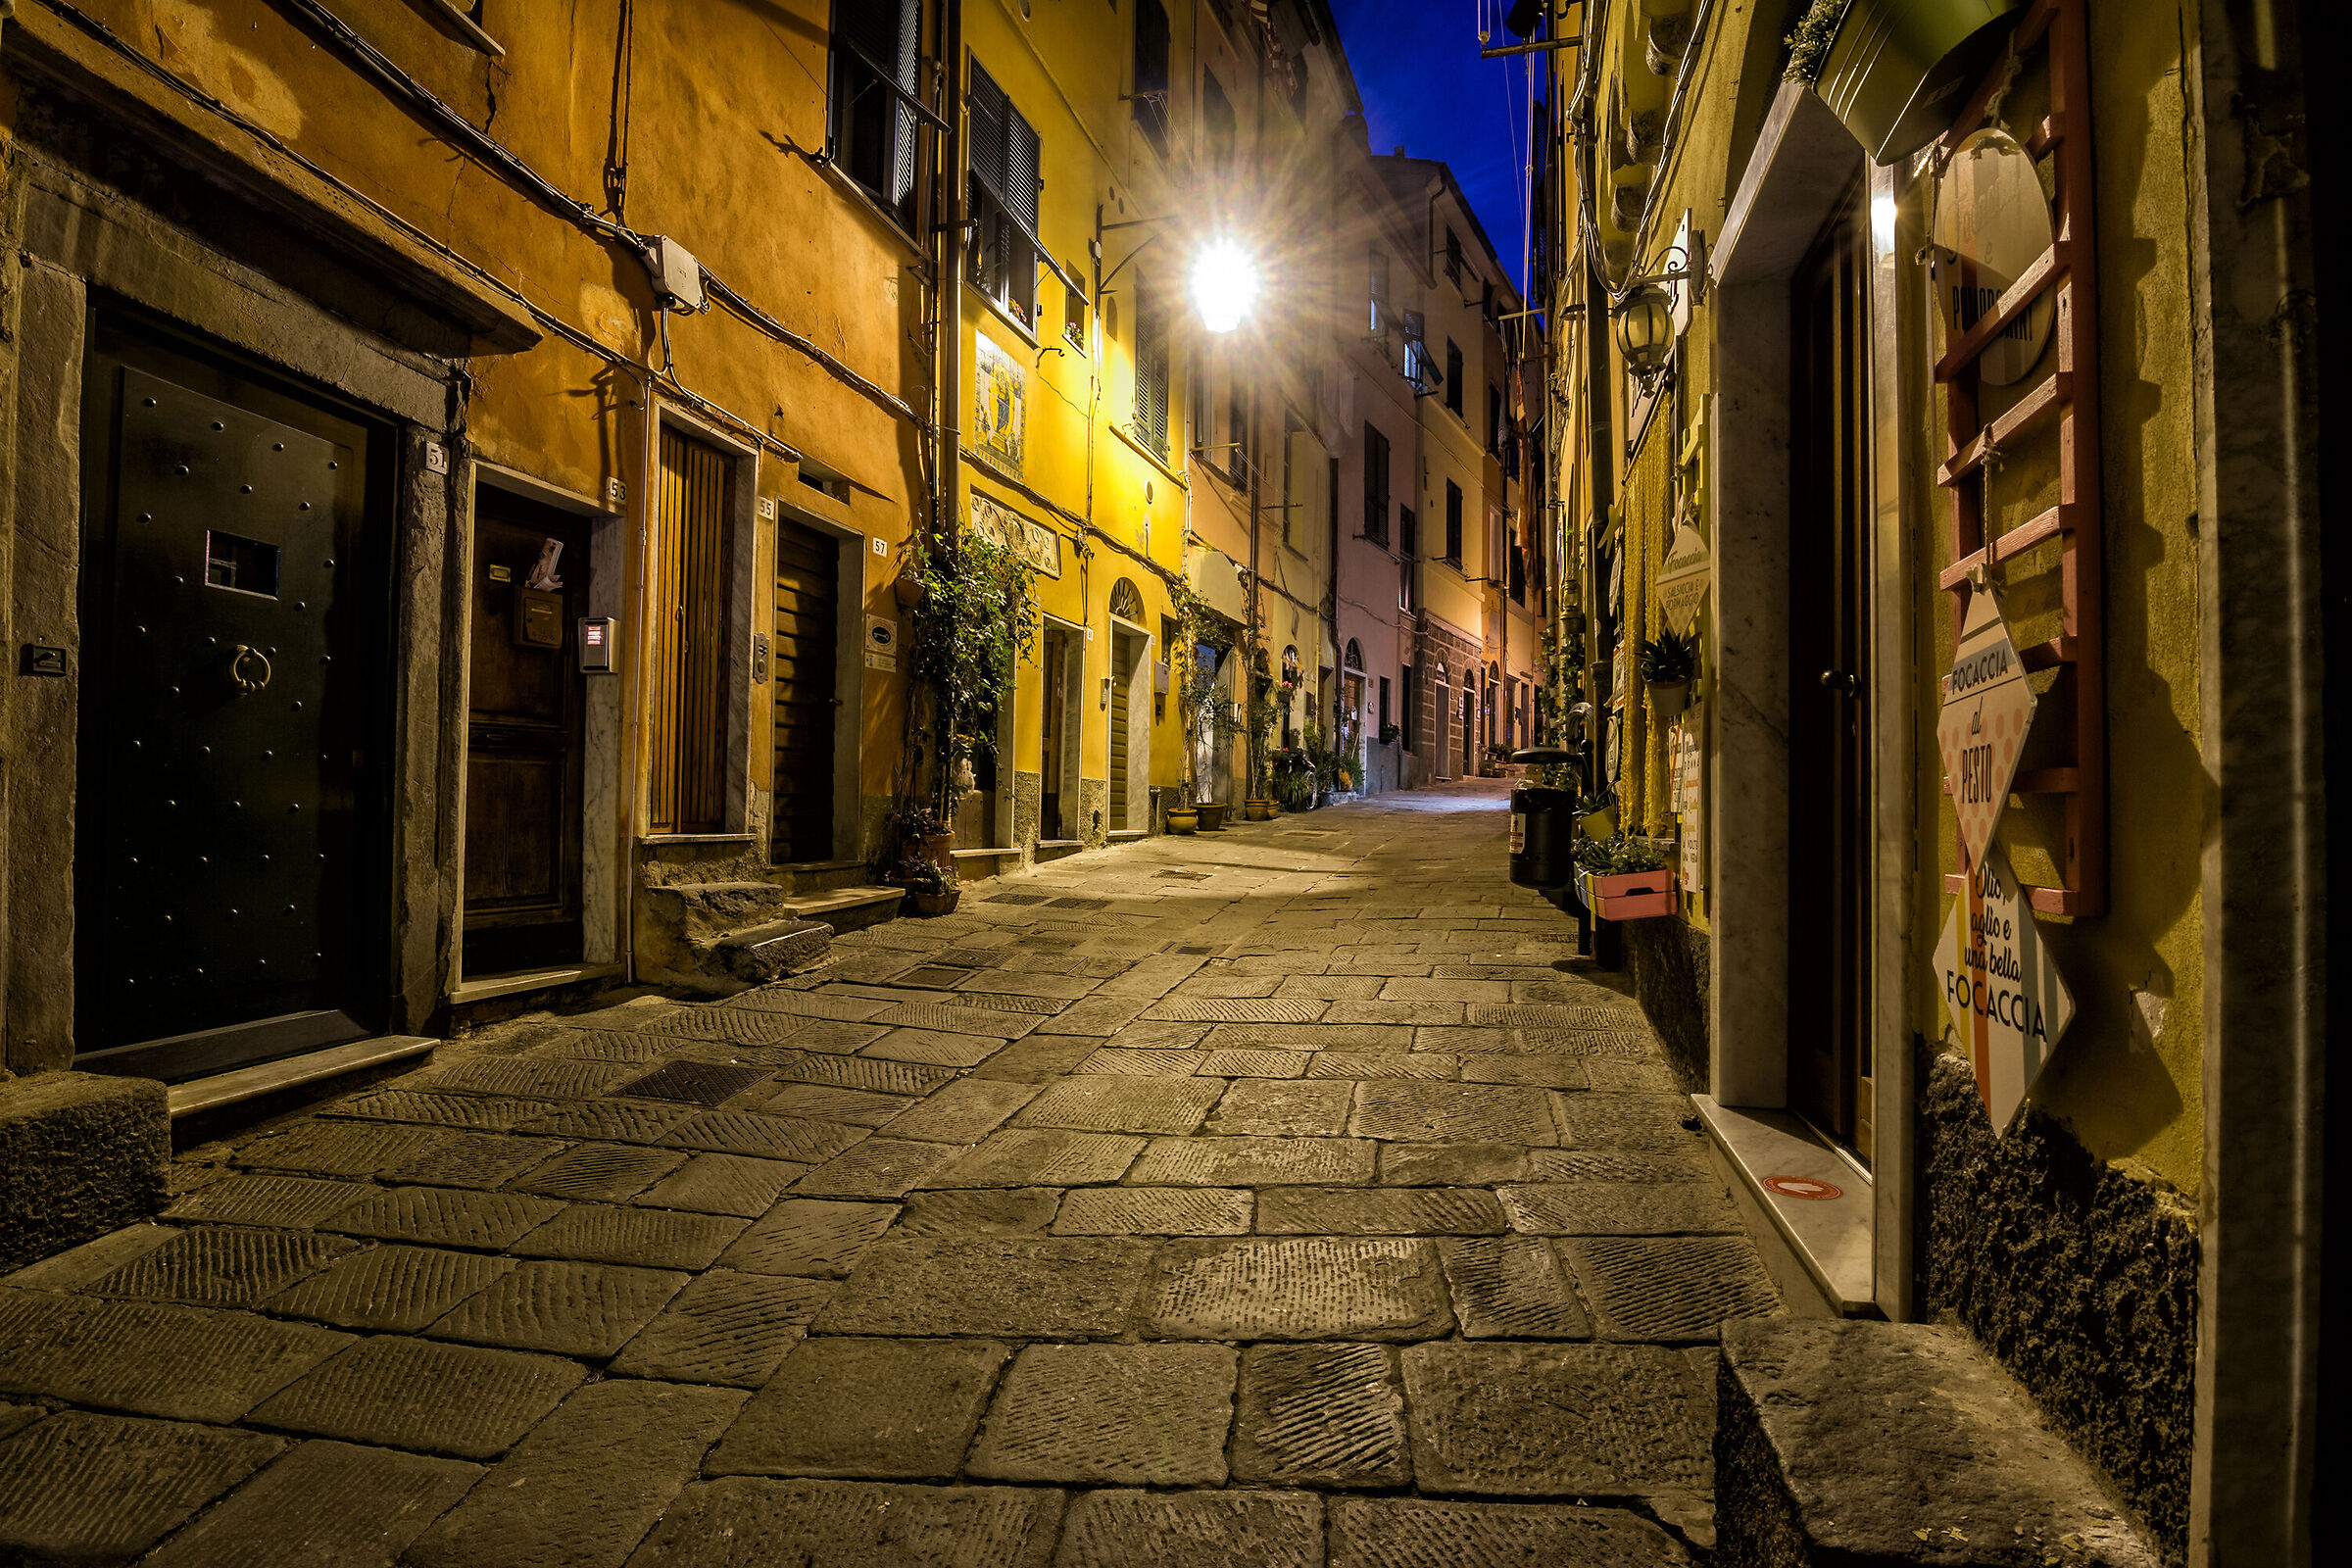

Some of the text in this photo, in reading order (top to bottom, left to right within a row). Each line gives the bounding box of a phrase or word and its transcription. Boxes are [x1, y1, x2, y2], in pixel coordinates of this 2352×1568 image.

[429, 447, 447, 468] 51
[612, 482, 627, 501] 53
[760, 500, 772, 515] 55
[875, 540, 886, 554] 57
[1668, 547, 1701, 574] Focaccia
[1952, 649, 2008, 696] FOCACCIA
[1971, 696, 1984, 736] al
[1962, 743, 1992, 805] PESTO
[1971, 905, 2012, 947] aglio e
[1965, 943, 2023, 983] una bella
[1946, 969, 2047, 1043] FOCACCIA
